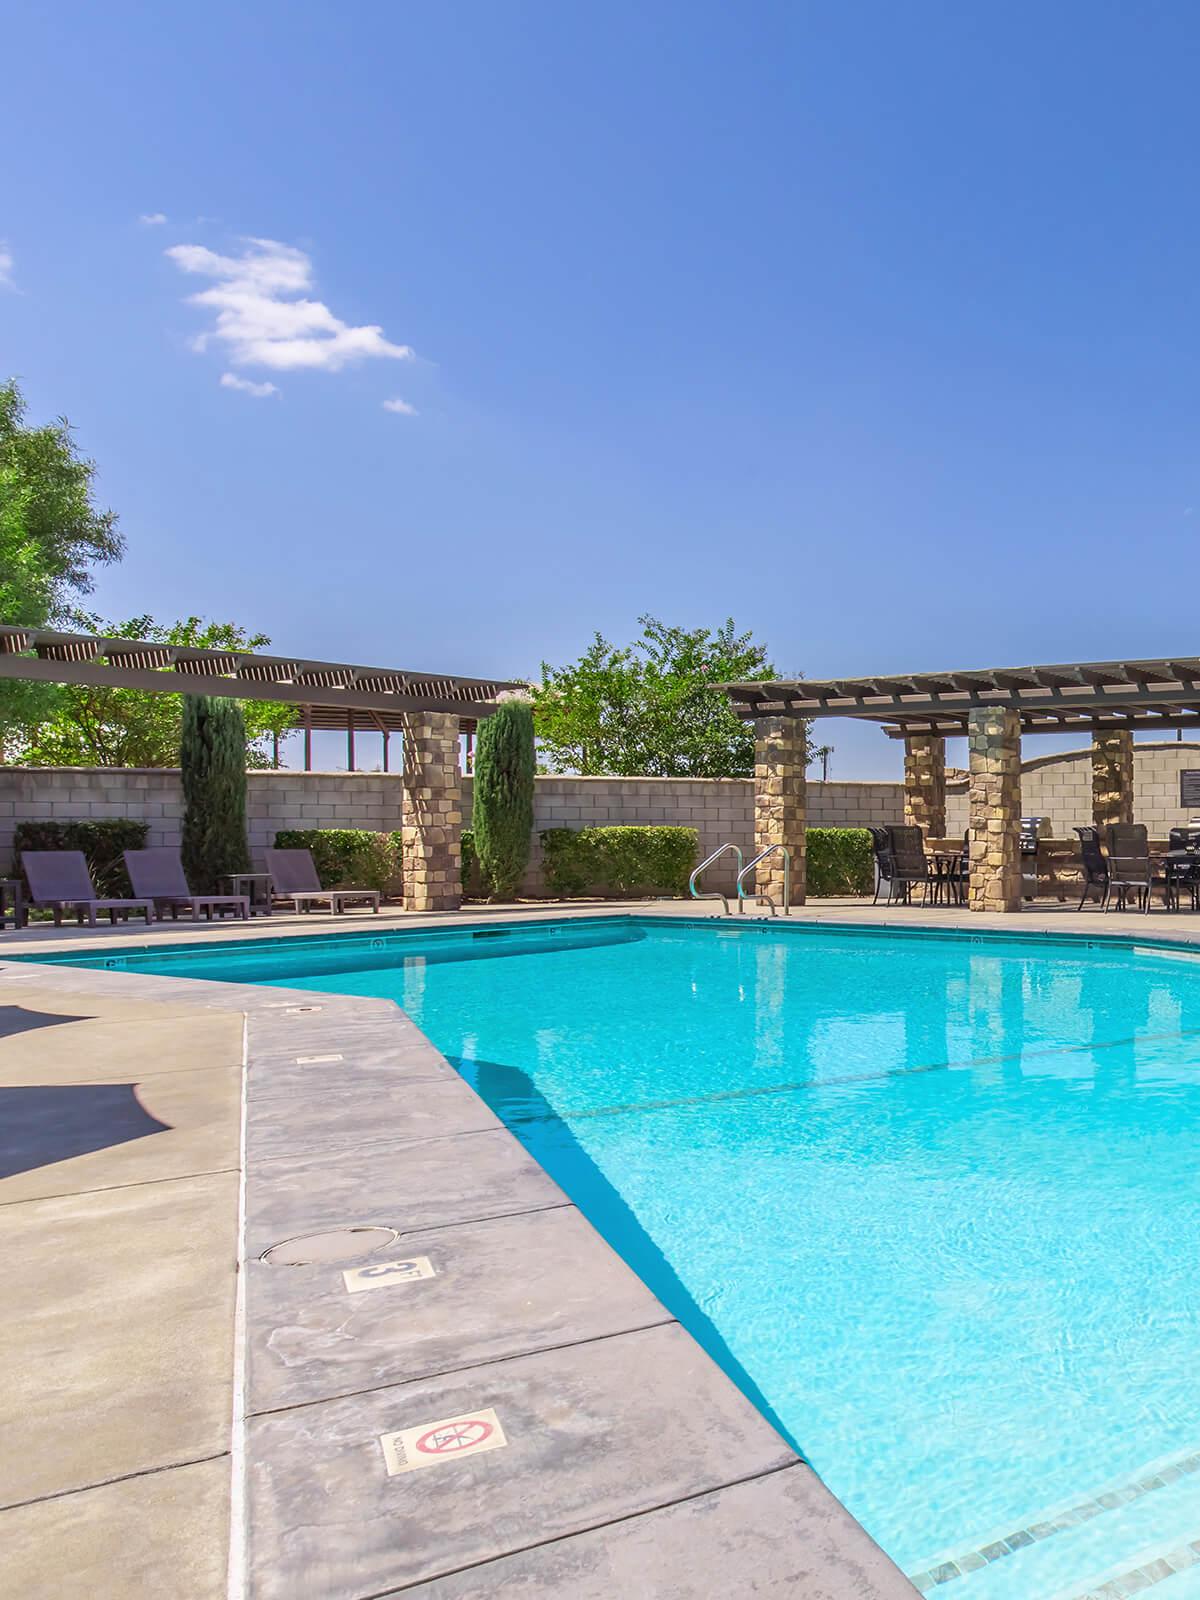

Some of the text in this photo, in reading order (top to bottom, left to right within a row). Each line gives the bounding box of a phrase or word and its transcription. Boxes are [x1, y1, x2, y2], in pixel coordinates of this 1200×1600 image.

[358, 1261, 417, 1278] 3
[393, 1436, 409, 1466] NO DIVING
